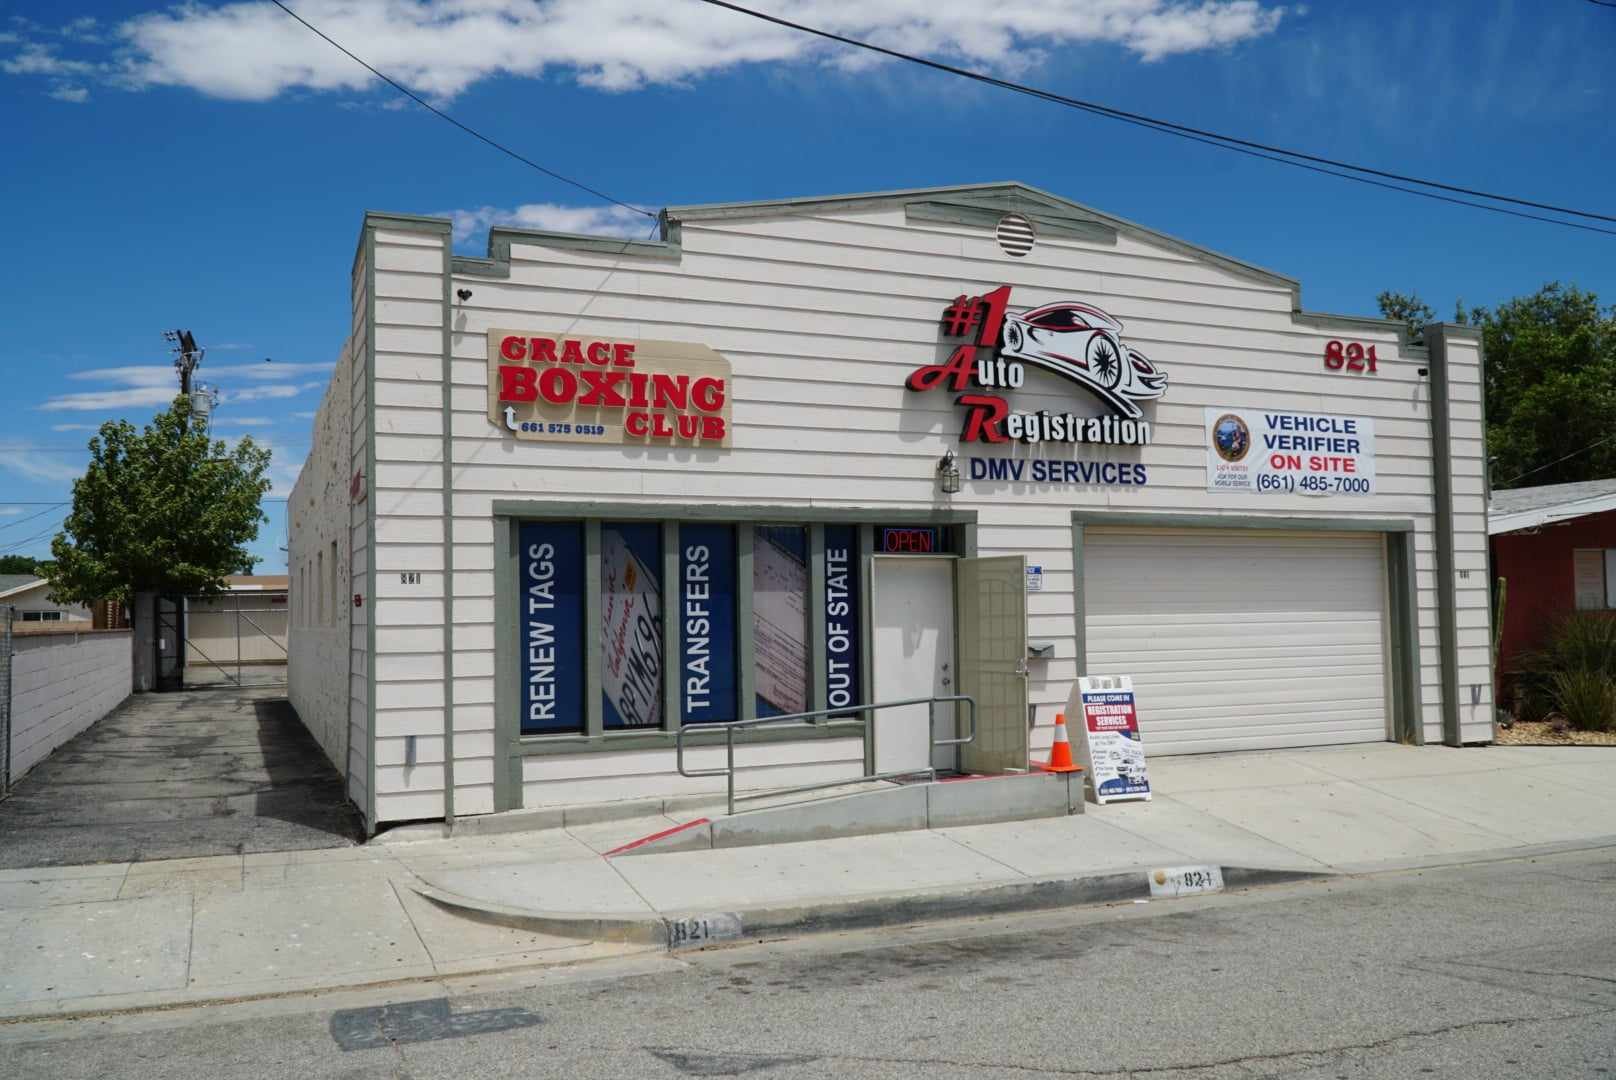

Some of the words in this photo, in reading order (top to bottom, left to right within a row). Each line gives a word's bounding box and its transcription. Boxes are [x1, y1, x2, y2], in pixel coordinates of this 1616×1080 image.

[943, 285, 1012, 347] #1
[500, 336, 636, 368] GRACE
[905, 345, 1025, 391] Auto
[1323, 340, 1378, 373] 821
[498, 366, 726, 412] BOXING
[521, 422, 544, 432] 661
[548, 423, 571, 433] 575
[575, 425, 604, 435] 0519
[625, 412, 726, 440] CLUB
[955, 394, 1151, 444] Registration
[1265, 414, 1357, 434] VEHICLE
[1264, 434, 1361, 454] VERIFIER
[970, 457, 1025, 481] DMV
[1032, 459, 1147, 485] SERVICES
[1270, 454, 1301, 470] ON
[1310, 456, 1356, 473] SITE
[1256, 474, 1295, 492] (661)
[1300, 476, 1370, 493] 485-7000
[886, 531, 931, 552] OPEN
[401, 572, 421, 585] 821
[529, 543, 554, 614] TAGS
[826, 548, 849, 616] STATE
[687, 545, 710, 713] TRANSFERS
[828, 622, 849, 653] OF
[530, 622, 555, 720] RENEW
[829, 659, 850, 707] OUT
